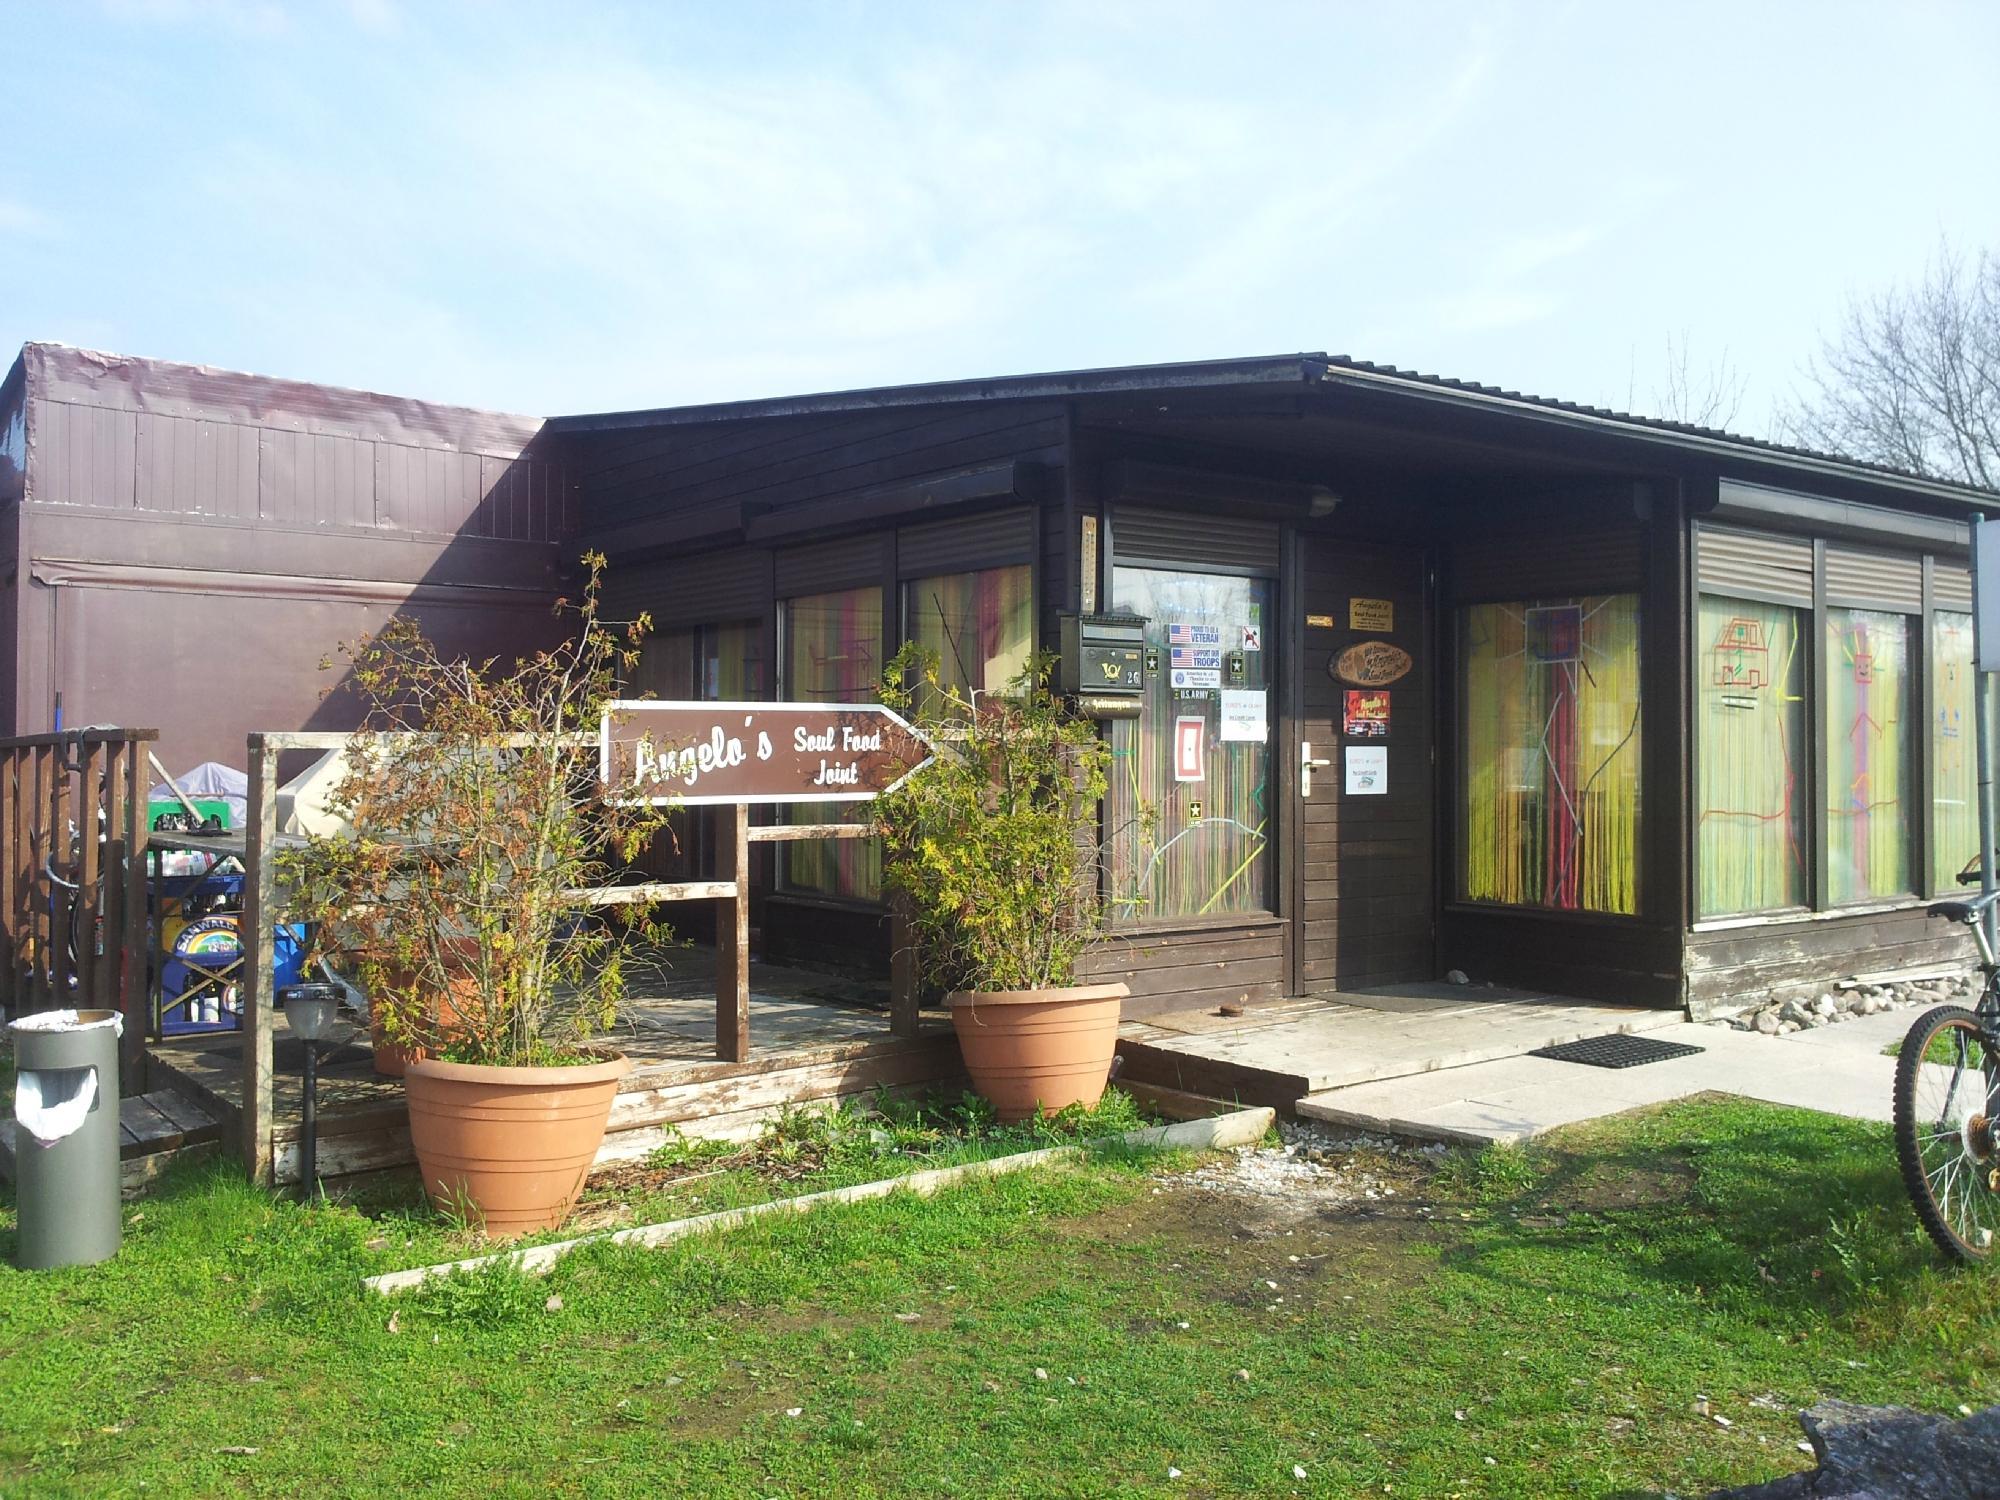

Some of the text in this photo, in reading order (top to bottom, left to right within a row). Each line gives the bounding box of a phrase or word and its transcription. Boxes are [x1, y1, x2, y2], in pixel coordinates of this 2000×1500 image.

[1191, 633, 1219, 643] VETERAN
[1194, 658, 1220, 667] TROOPS
[1191, 690, 1209, 699] ARMY
[793, 726, 881, 752] Soul Food
[813, 759, 858, 785] Joint
[177, 919, 235, 952] SANWALD
